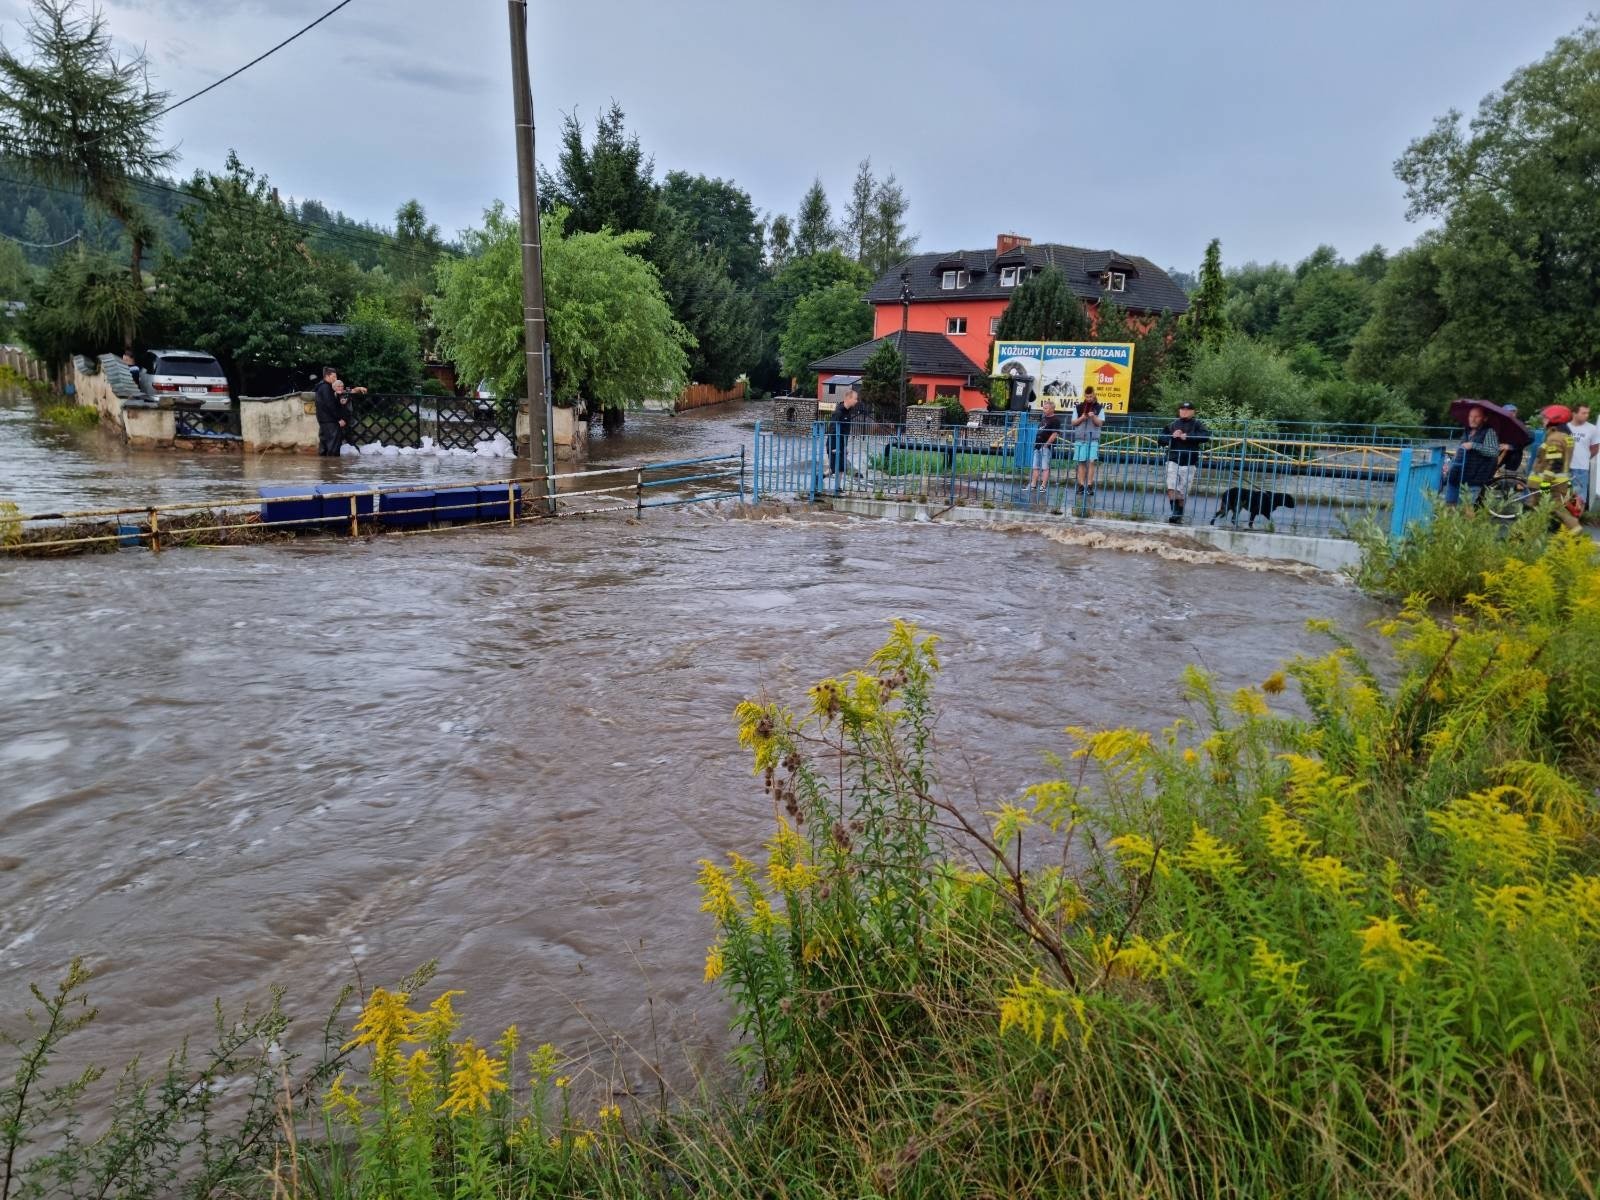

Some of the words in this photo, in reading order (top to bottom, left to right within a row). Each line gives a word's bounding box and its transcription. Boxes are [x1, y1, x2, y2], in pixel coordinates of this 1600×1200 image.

[1001, 345, 1041, 356] KOŻUCHY
[1046, 346, 1077, 357] ODZIEŻ
[1079, 346, 1127, 358] SKÓRZANA
[1099, 373, 1105, 383] 3
[1117, 401, 1123, 411] 1
